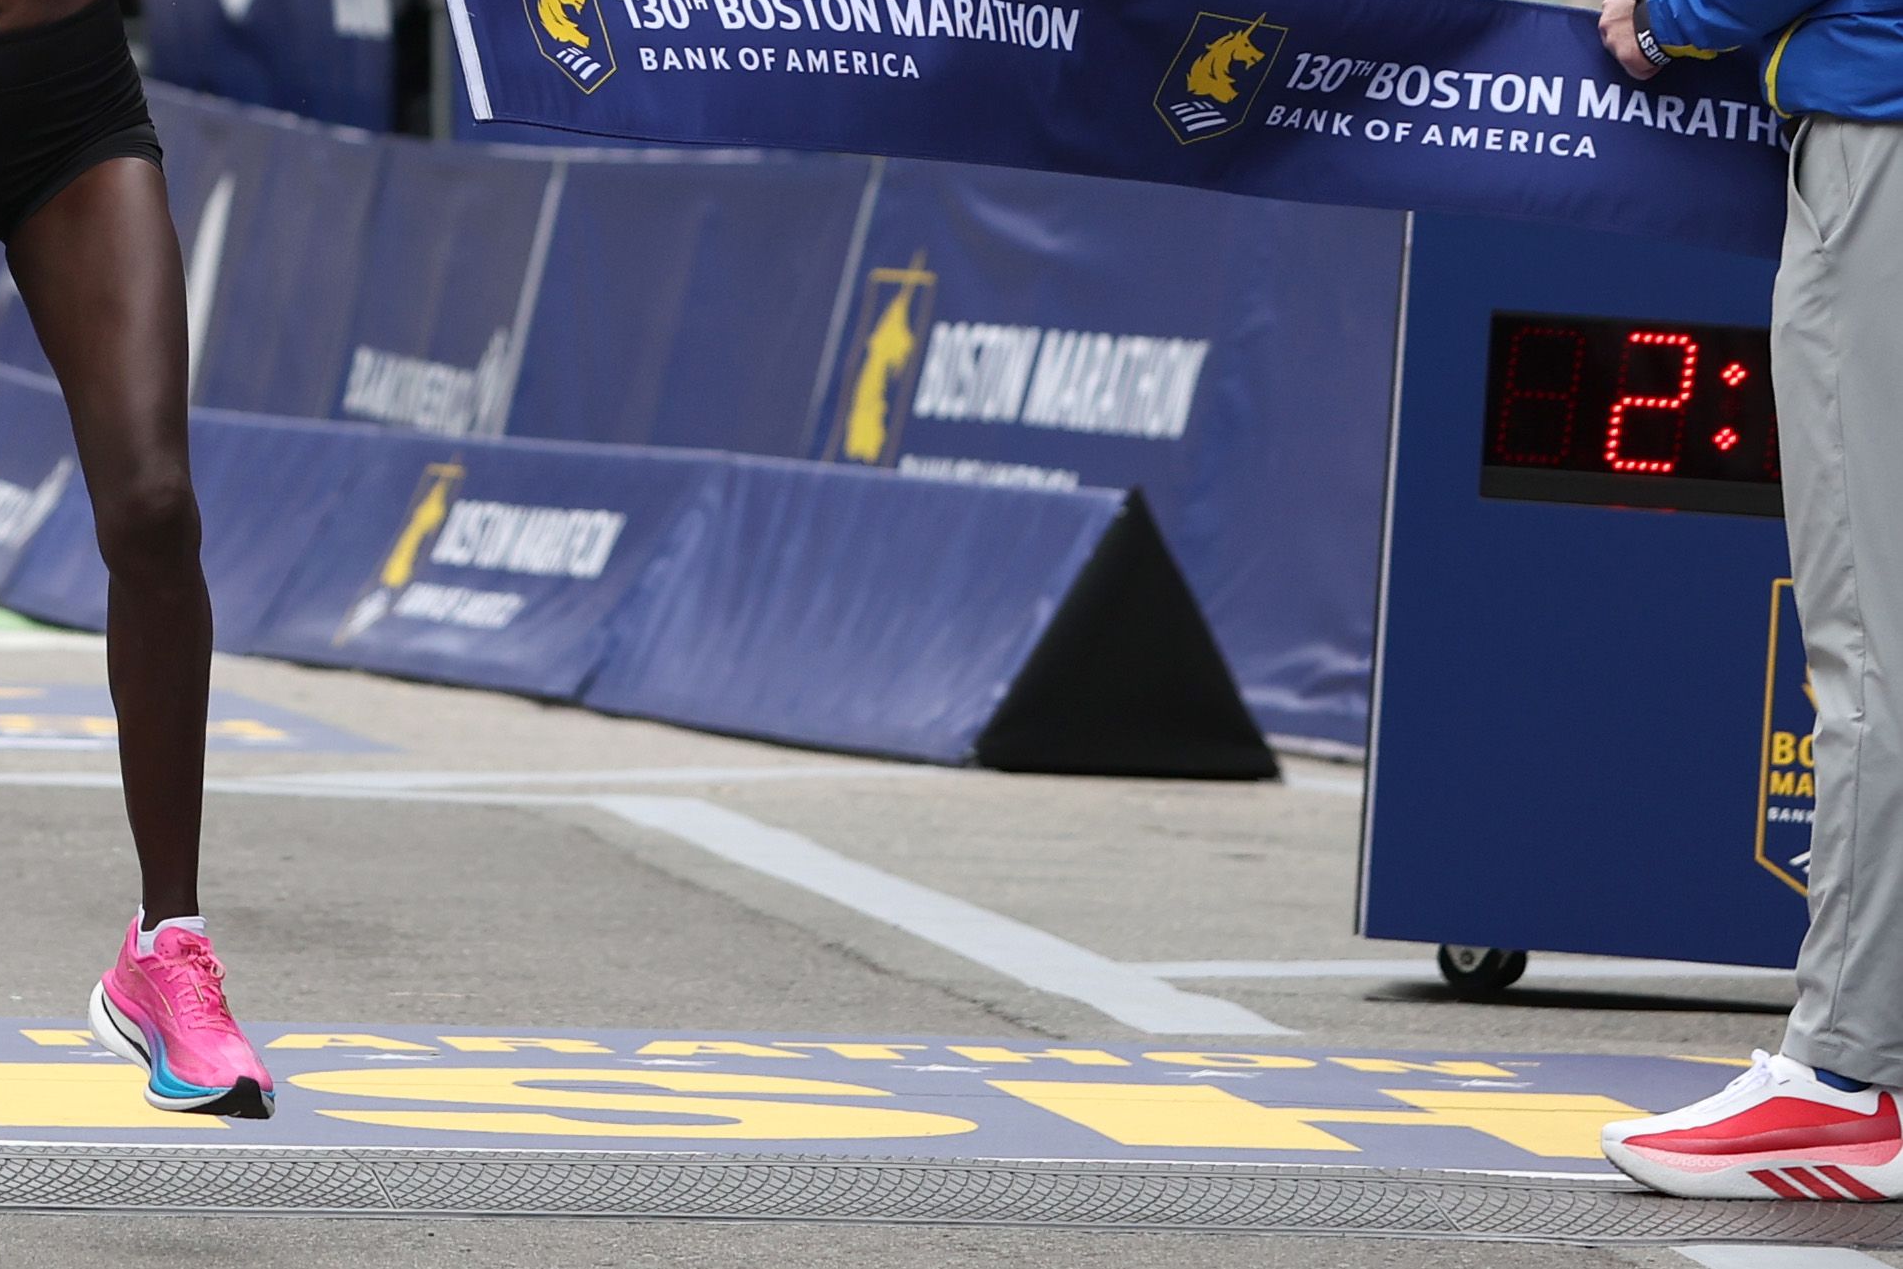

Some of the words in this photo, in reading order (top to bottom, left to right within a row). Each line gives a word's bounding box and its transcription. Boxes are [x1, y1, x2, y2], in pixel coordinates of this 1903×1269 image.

[639, 46, 731, 72] BANK
[739, 47, 778, 73] OF
[786, 48, 921, 80] AMERICA
[1285, 51, 1378, 93] 130TH
[1364, 62, 1564, 116] BOSTON
[1265, 104, 1354, 138] BANK
[1364, 118, 1414, 143] OF
[1420, 124, 1597, 159] AMERICA
